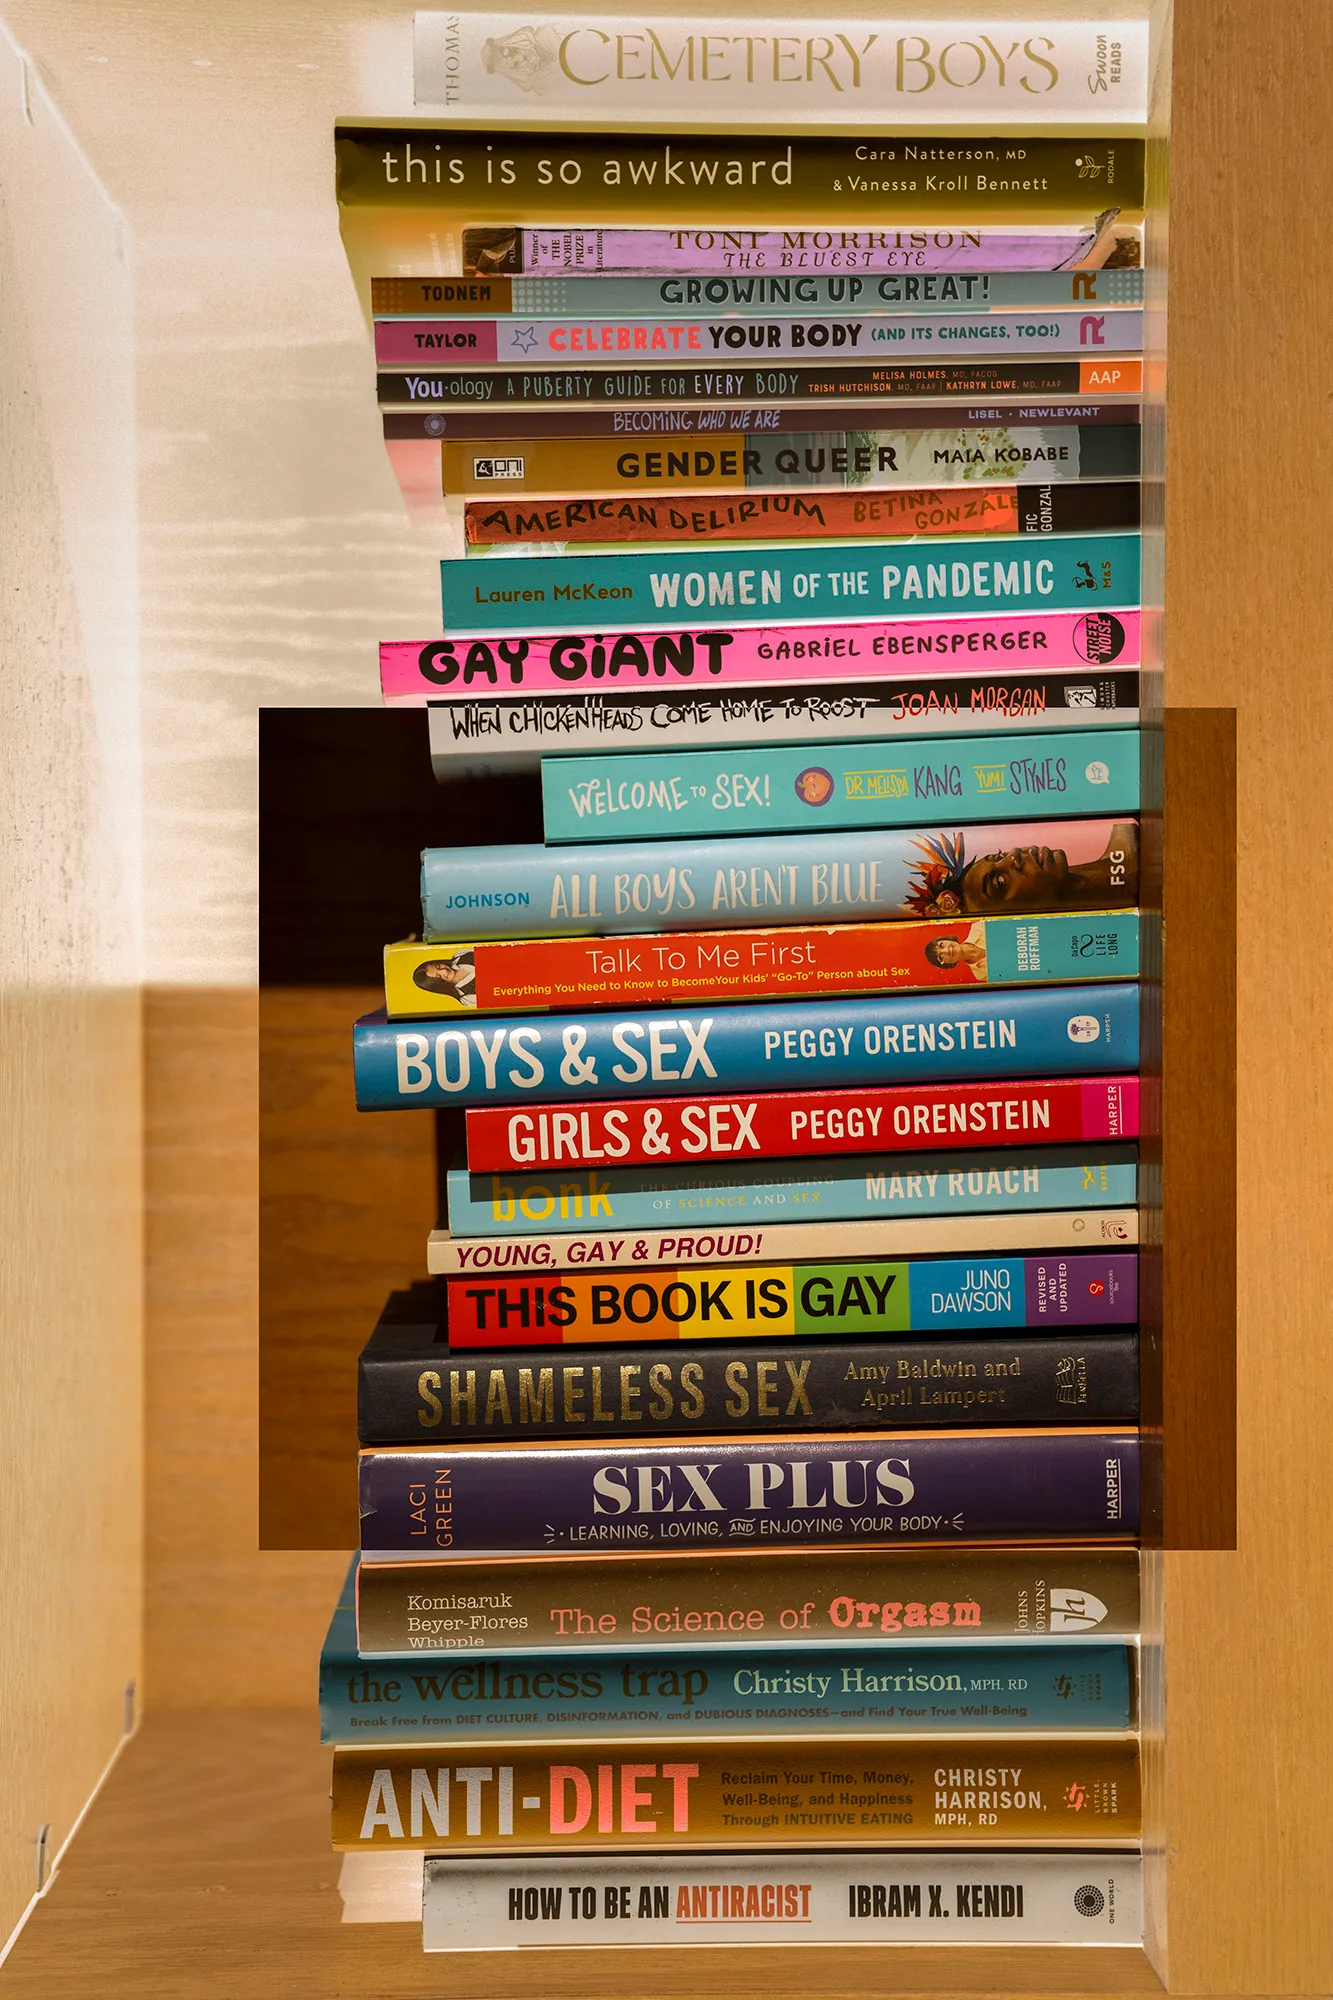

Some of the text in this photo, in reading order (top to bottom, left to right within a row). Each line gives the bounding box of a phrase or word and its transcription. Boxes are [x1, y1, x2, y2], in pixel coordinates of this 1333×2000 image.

[446, 15, 460, 106] THOMAS
[559, 28, 1059, 94] CEMETERY BOYS
[1111, 42, 1122, 83] READS
[382, 144, 793, 186] this is so awkward
[856, 147, 1027, 162] Cara Natterson, MD
[848, 175, 1048, 192] Vanessa Kroll Bennett
[782, 229, 982, 250] MORRISON
[887, 251, 926, 267] EYE
[421, 286, 491, 301] TODNEM
[660, 275, 991, 304] GROWING UP GREAT!
[414, 333, 477, 349] TAYLOR
[549, 323, 1060, 351] CELEBRATE YOUR BODY (AND ITS CHANGES, TOO!)
[523, 374, 744, 398] PUBERTY GUIDE EVERY
[1089, 371, 1121, 385] AAP
[968, 407, 1100, 420] LISEL NEWLEVANT
[616, 446, 899, 478] GENDER QUEER
[995, 446, 1069, 463] KOBABE
[482, 500, 657, 536] AMERICAN
[1025, 513, 1038, 532] FIC
[1040, 485, 1053, 532] GONZAL
[475, 582, 633, 604] Lauren McKeon
[650, 559, 1055, 608] WOMEN OF THE PANDEMIC
[872, 631, 1048, 656] EBENSPERGER
[1086, 617, 1100, 661] STREET
[1098, 619, 1112, 655] NOISE
[418, 639, 530, 685] GAY
[971, 686, 1046, 717] MORGAN
[569, 776, 689, 818] WELCOME
[1110, 850, 1125, 887] FSG
[445, 892, 530, 910] JOHNSON
[550, 861, 884, 919] ALL BOYS BLUE
[586, 940, 816, 975] Talk Me First
[1016, 926, 1029, 972] DEBORAH
[1028, 925, 1041, 971] ROFFMAN
[493, 966, 911, 998] Everything You Need Know Person about Sex
[764, 1019, 1016, 1060] PEGGY ORENSTEIN
[396, 1018, 718, 1094] BOYS & SEX
[790, 1099, 1050, 1140] PEGGY ORENSTEIN
[1109, 1085, 1117, 1136] HARPER
[508, 1103, 761, 1162] GIRLS & SEX
[949, 1165, 1039, 1197] ROACH
[678, 1191, 821, 1209] SCIENCE AND SEX
[456, 1233, 763, 1268] YOUNG, GAY PROUD!
[960, 1268, 1010, 1292] JUNO
[1038, 1266, 1047, 1313] REVISED
[1048, 1278, 1057, 1301] AND
[1058, 1262, 1068, 1313] UPDATED
[466, 1274, 897, 1330] THIS BOOK IS GAY
[931, 1291, 1011, 1315] DAWSON
[897, 1358, 977, 1380] Baldwin
[417, 1359, 814, 1428] SHAMELESS SEX
[592, 1457, 916, 1516] SEX PLUS
[1106, 1458, 1118, 1519] HARPER
[435, 1469, 453, 1548] GREEN
[660, 1516, 893, 1538] LOVING, YOUR
[407, 1593, 513, 1611] Komisaruk
[550, 1594, 983, 1635] The Science Orgasm
[1014, 1590, 1030, 1633] JOHNS
[407, 1614, 529, 1635] Beyer-Flores
[407, 1634, 485, 1649] Whipple
[412, 1659, 604, 1702] wellness
[733, 1667, 1028, 1699] Christy Harrison, MPH, RD
[350, 1704, 1027, 1728] Break Free from DIET CULTURE, DISINFORMATION, and DUBIOUS Find Your True Well-Being
[721, 1771, 914, 1786] Reclaim Your Time, Money,
[934, 1768, 1022, 1788] CHRISTY
[359, 1763, 699, 1839] ANTI-DIET
[721, 1792, 914, 1808] Well-Being, and Happiness
[721, 1812, 914, 1828] Through INTUITIVE EATING
[934, 1812, 998, 1828] MPH, RD
[508, 1884, 812, 1921] HOW TO BE AN ANTIRACIST
[849, 1884, 1024, 1918] IBRAM KENDI
